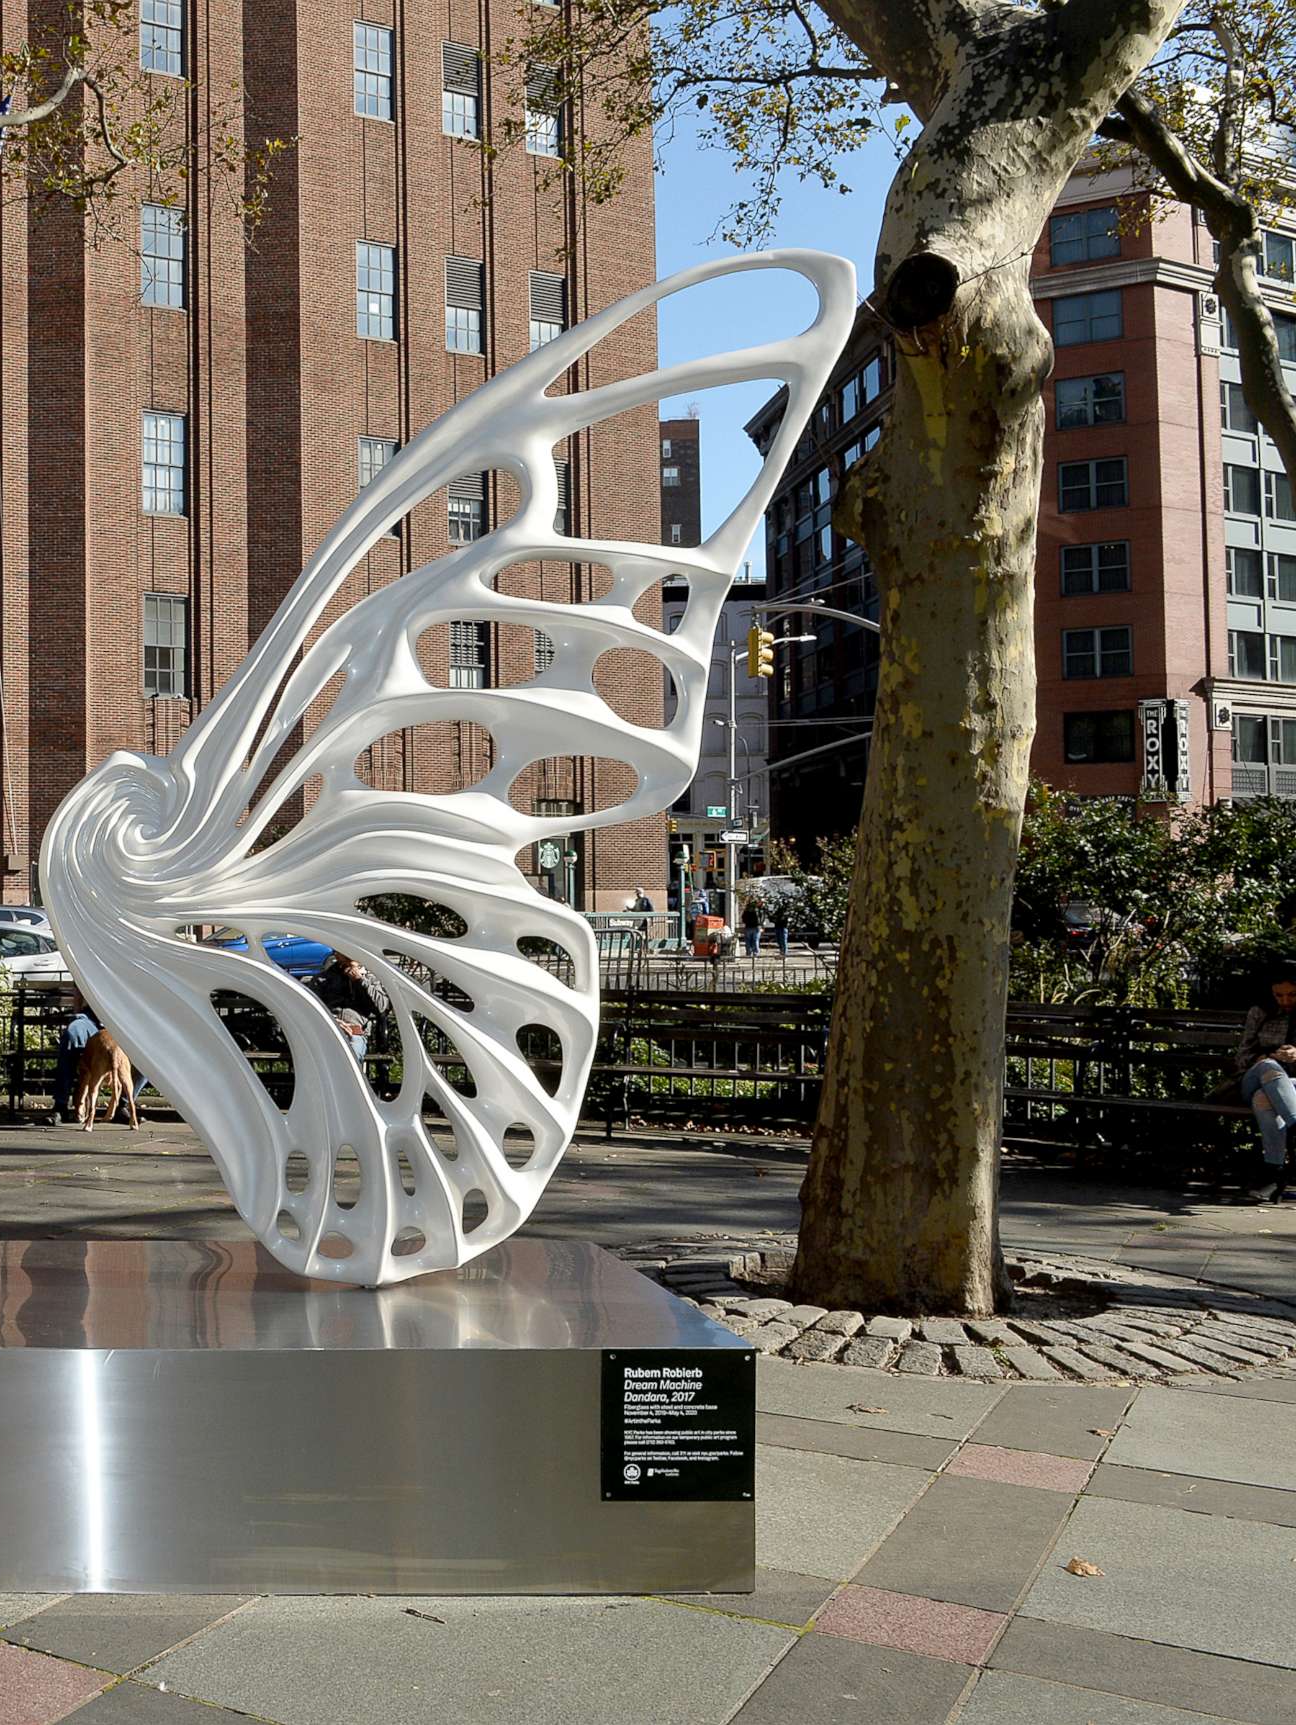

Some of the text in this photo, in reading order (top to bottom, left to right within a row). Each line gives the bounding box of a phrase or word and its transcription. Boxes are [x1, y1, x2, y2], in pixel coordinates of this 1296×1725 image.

[1146, 719, 1160, 788] ROXY
[609, 918, 634, 928] Subway
[624, 1367, 703, 1378] Rubem Robierb
[624, 1380, 703, 1390] Dream Machine
[624, 1391, 696, 1403] Dandara, 2017
